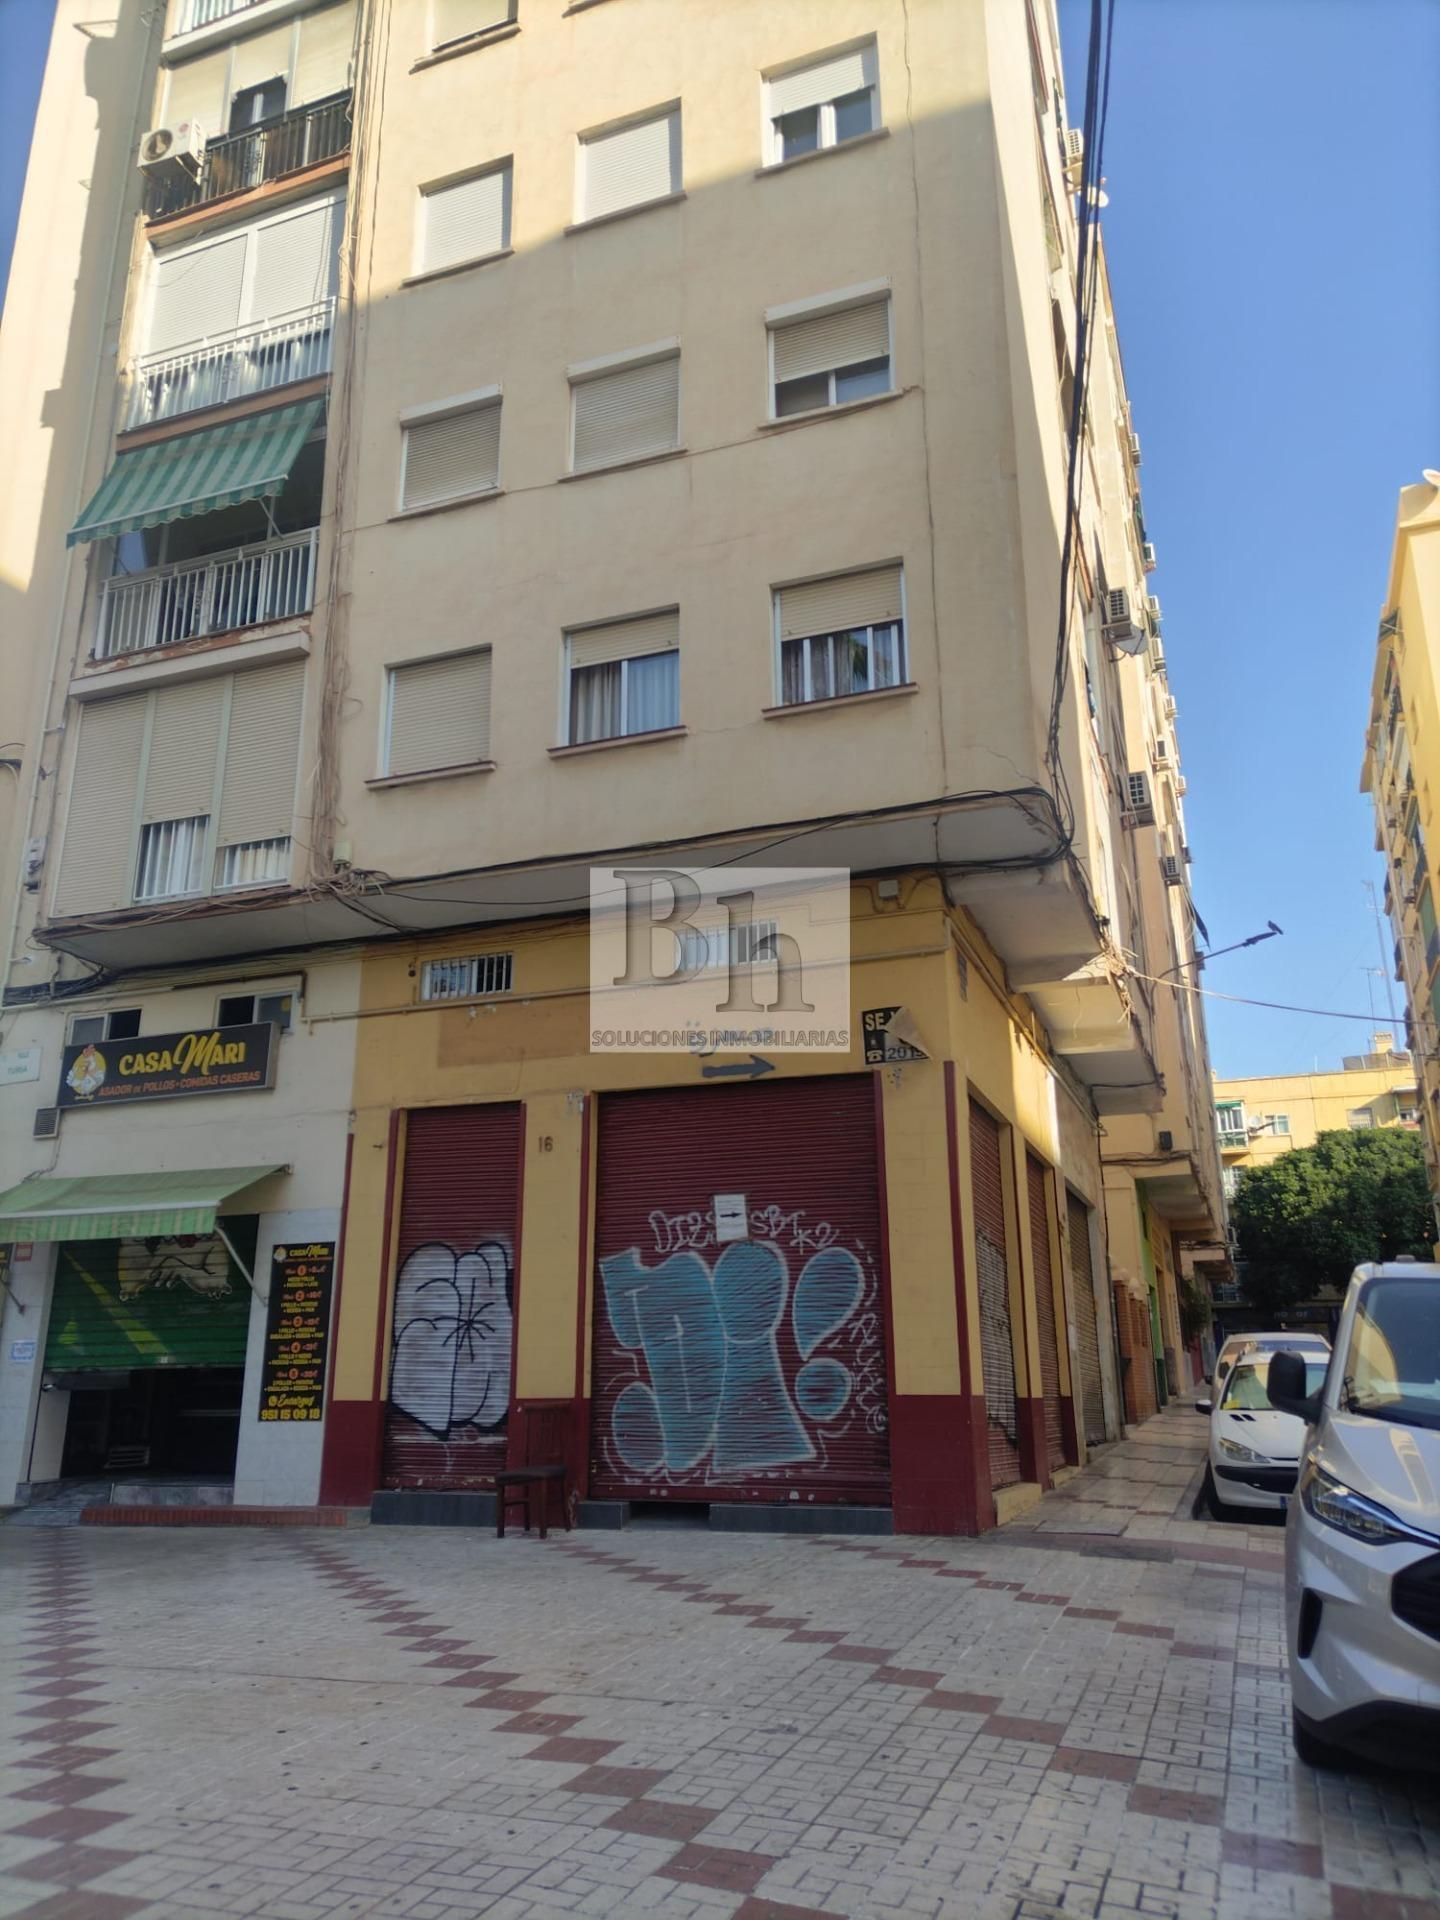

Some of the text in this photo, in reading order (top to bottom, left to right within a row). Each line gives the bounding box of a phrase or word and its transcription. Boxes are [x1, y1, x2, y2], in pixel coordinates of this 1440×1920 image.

[119, 1050, 172, 1076] CASA
[98, 1084, 132, 1097] ASADOR
[143, 1080, 176, 1092] POLLOS
[180, 1075, 218, 1088] COMIDAS
[219, 1071, 261, 1085] CASERAS
[538, 1136, 553, 1153] 16
